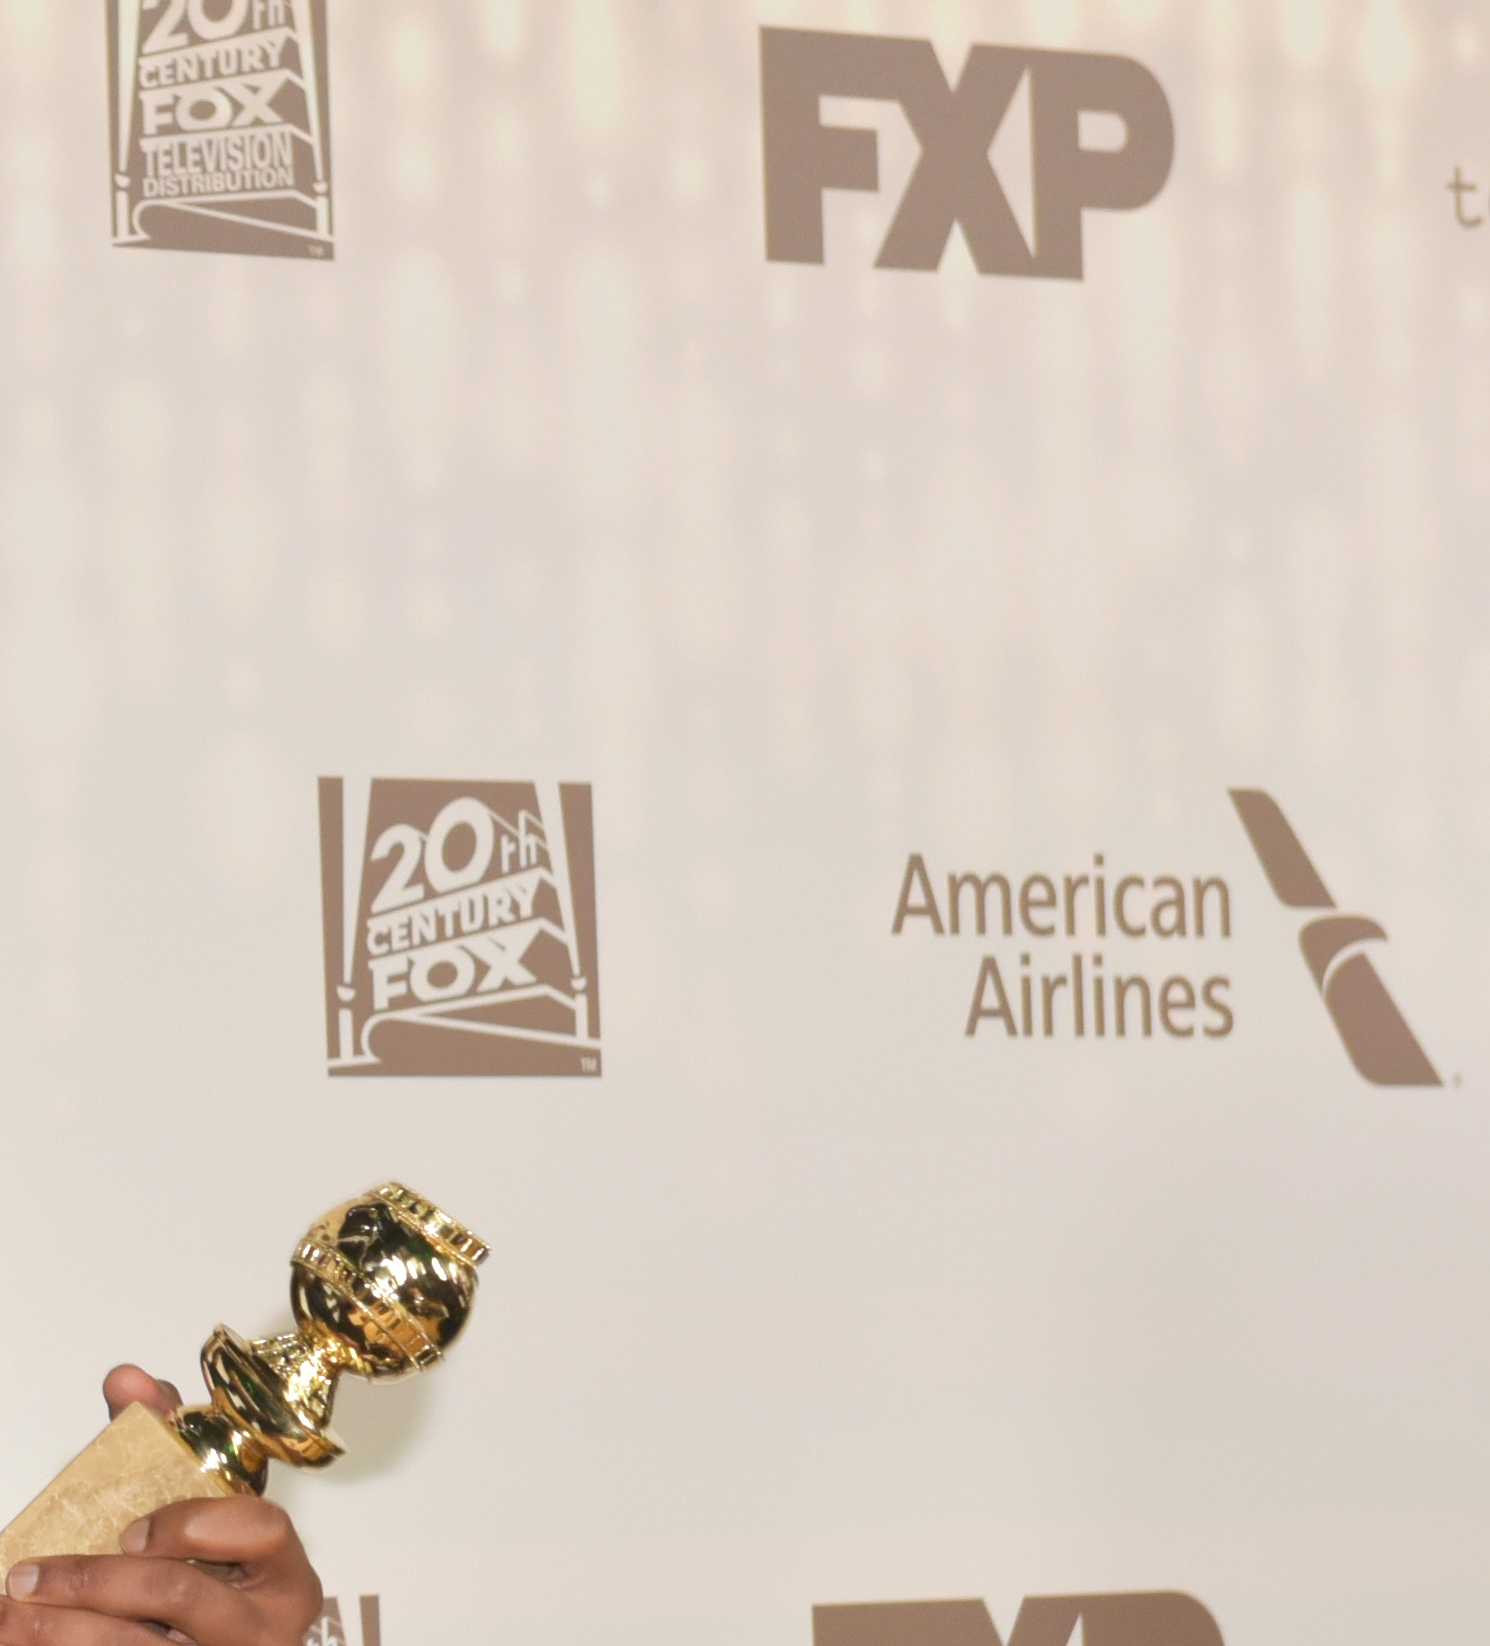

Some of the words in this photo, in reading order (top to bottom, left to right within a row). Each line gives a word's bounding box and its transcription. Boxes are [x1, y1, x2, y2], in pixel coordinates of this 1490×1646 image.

[139, 27, 287, 89] CENTURY
[139, 70, 287, 135] FOX
[139, 130, 293, 178] TELEVISION
[142, 167, 294, 197] DISTRIBUTION
[759, 25, 1175, 281] FXP
[367, 868, 541, 957] CENTURY
[891, 852, 1232, 938] American
[368, 920, 541, 1011] FOX
[964, 953, 1235, 1038] Airlines
